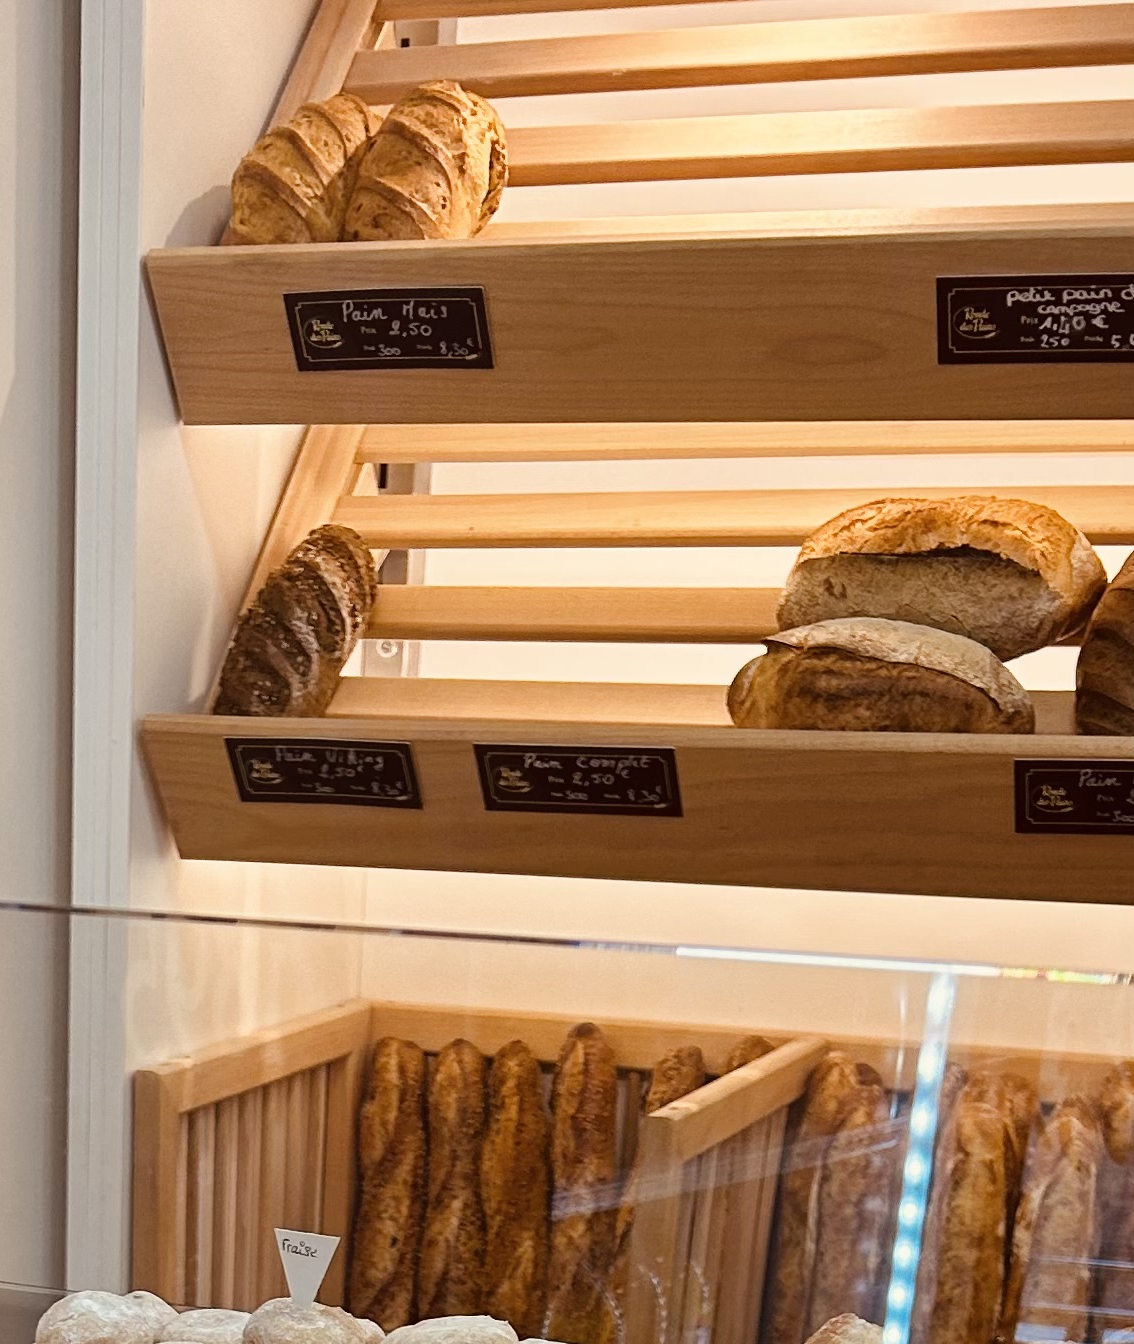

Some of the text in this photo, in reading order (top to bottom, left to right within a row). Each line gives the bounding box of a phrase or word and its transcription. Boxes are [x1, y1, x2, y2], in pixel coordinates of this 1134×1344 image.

[1062, 285, 1113, 304] pain
[341, 300, 388, 322] Pain
[1037, 301, 1126, 316] campagne
[1040, 334, 1071, 349] 250
[523, 753, 564, 769] Pain
[1077, 768, 1122, 788] Pain
[282, 1238, 320, 1259] Fraise
